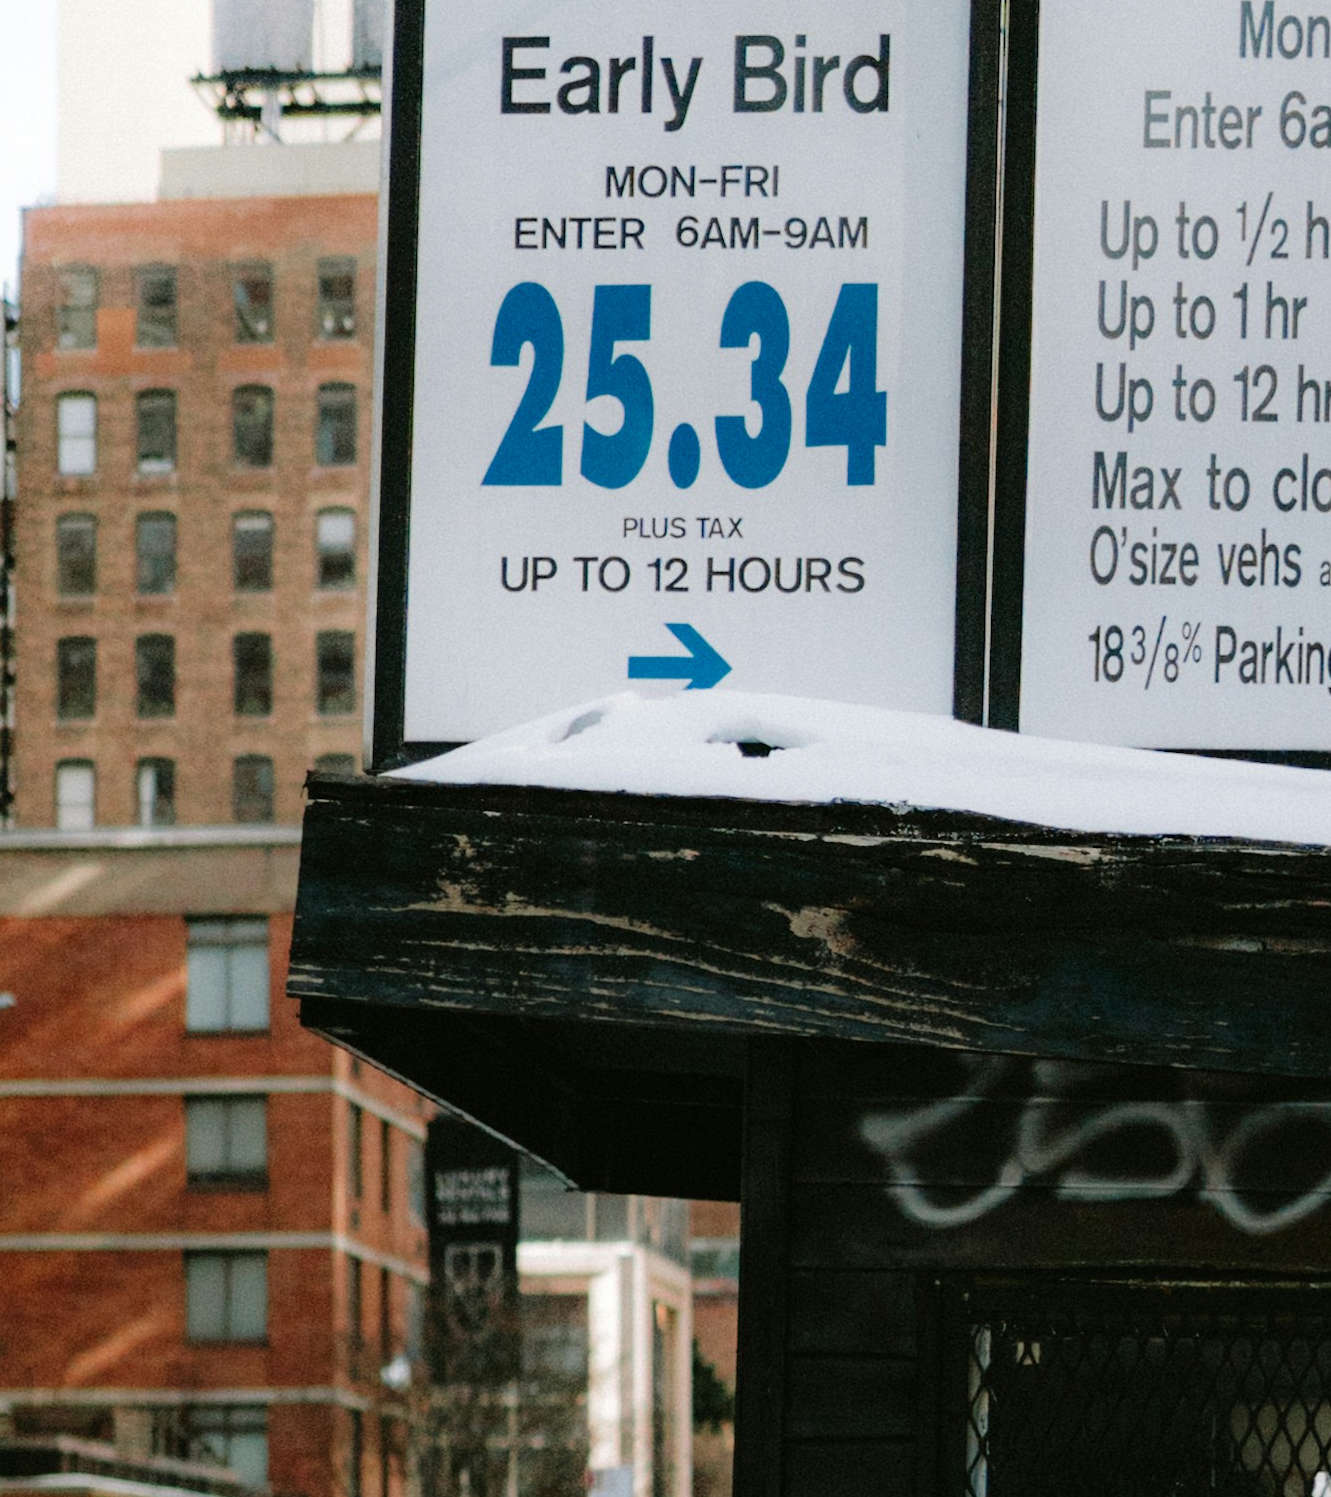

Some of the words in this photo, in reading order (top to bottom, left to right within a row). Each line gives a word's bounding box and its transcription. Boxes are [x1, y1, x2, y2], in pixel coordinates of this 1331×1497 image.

[500, 35, 703, 133] Early
[733, 33, 891, 114] Bird
[1143, 90, 1263, 151] Enter
[605, 164, 779, 199] MON-FRI
[514, 216, 645, 250] ENTER
[675, 215, 868, 250] 6AM-9AM
[1100, 200, 1159, 271] Up
[1175, 201, 1220, 261] to
[1098, 280, 1156, 351] Up
[1173, 281, 1216, 340] to
[1233, 282, 1249, 340] 1
[1265, 280, 1308, 340] hr
[481, 280, 888, 490] 25.34
[1095, 362, 1154, 434] Up
[1172, 364, 1216, 423] to
[1233, 364, 1279, 423] 12
[1092, 450, 1182, 510] Max
[1206, 453, 1251, 512] to
[622, 516, 687, 540] PLUS
[696, 516, 743, 539] TAX
[1090, 525, 1200, 587] O'size
[1217, 528, 1302, 588] vehs
[501, 556, 558, 593] UP
[573, 555, 631, 593] TO
[647, 557, 689, 593] 12
[706, 556, 865, 594] HOURS
